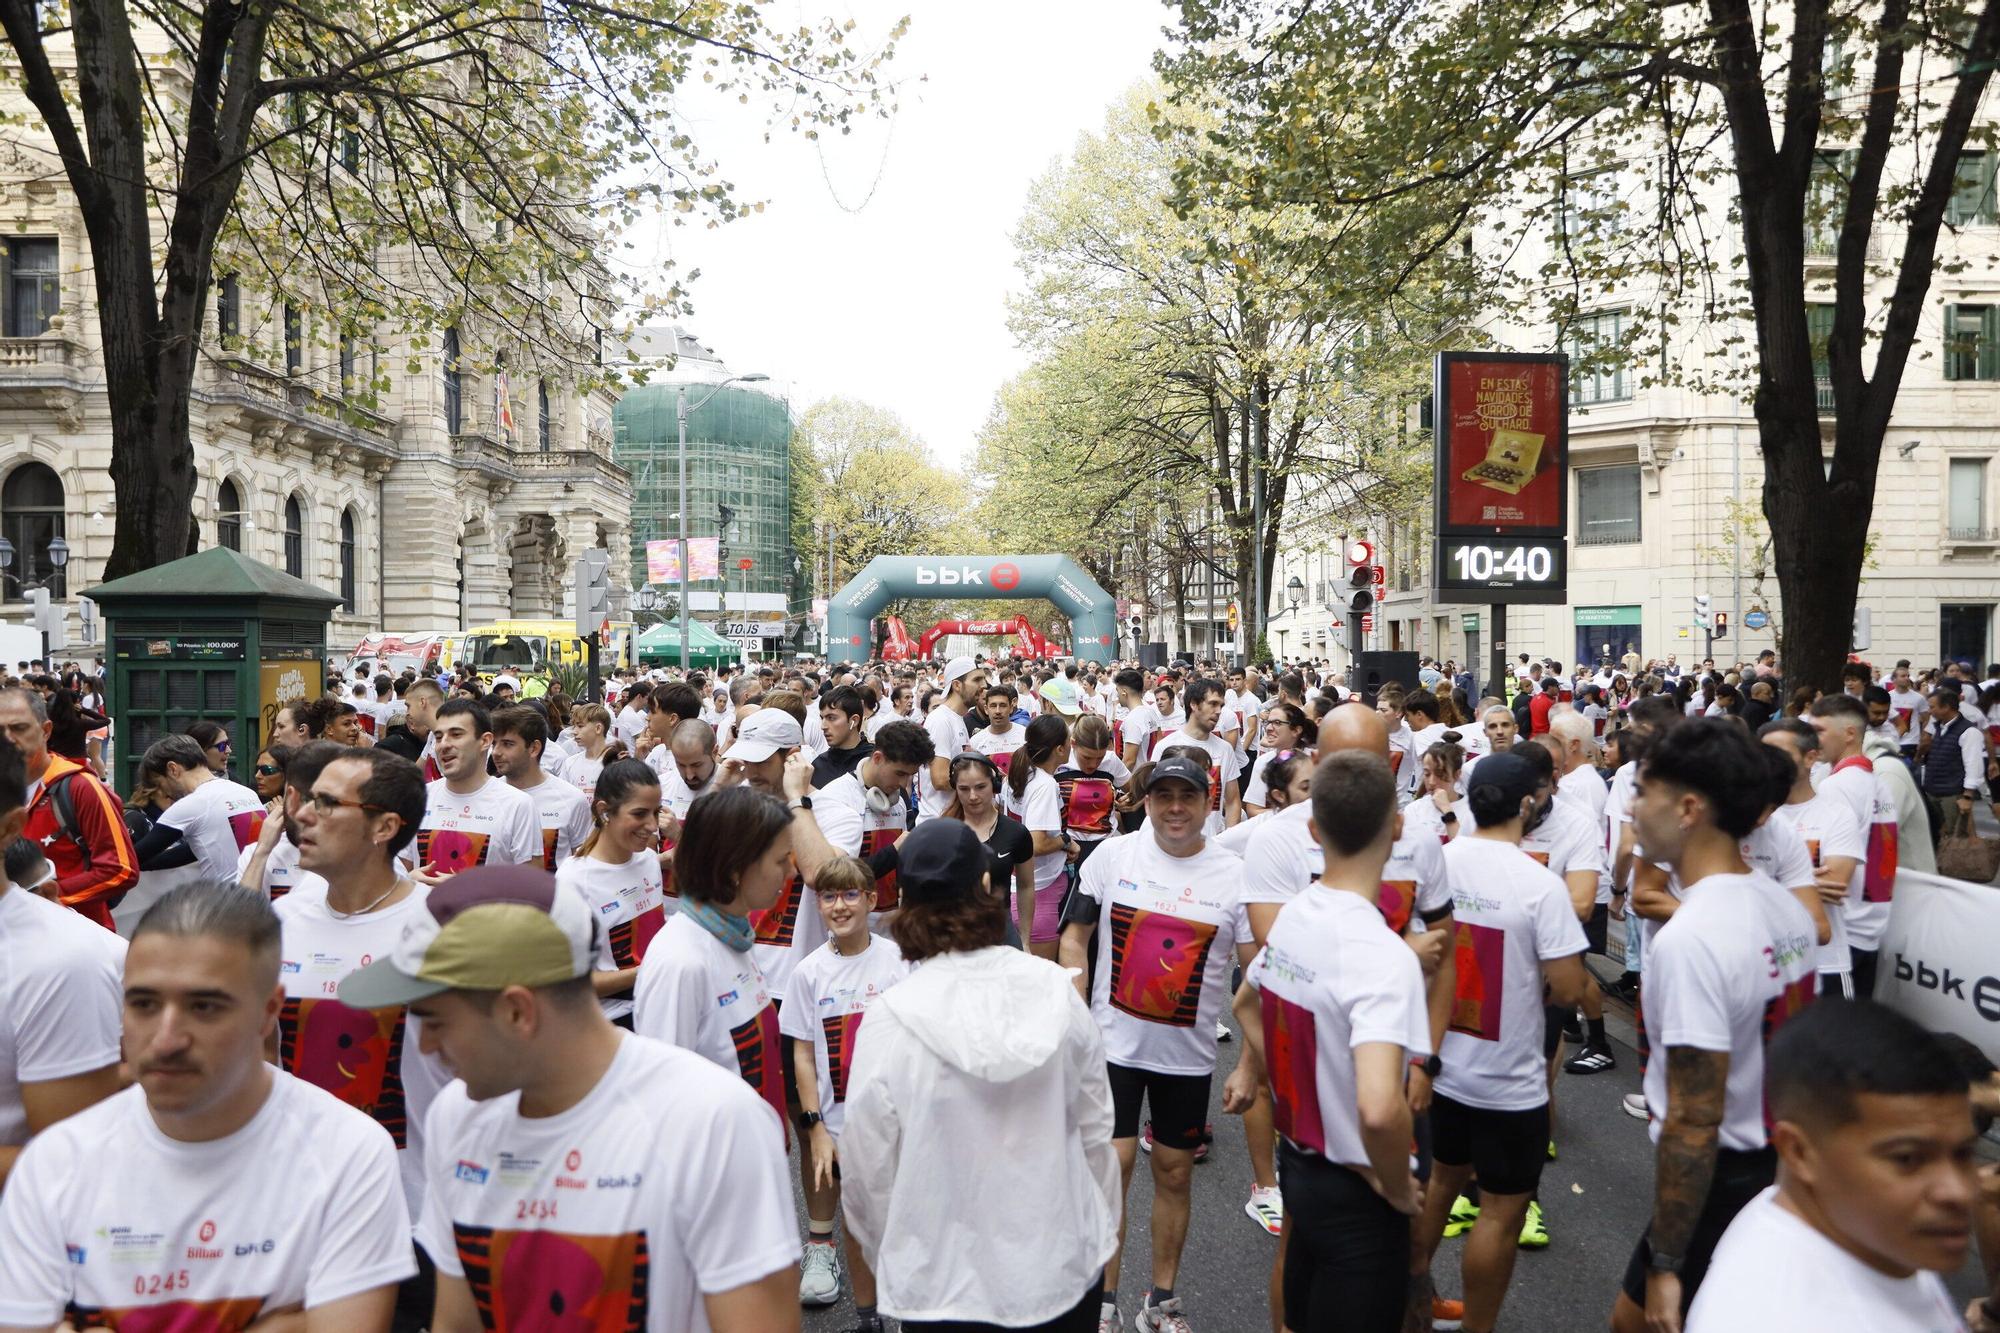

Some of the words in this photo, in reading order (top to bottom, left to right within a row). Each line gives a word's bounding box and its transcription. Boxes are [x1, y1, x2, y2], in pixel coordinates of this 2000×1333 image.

[1481, 378, 1494, 390] EN
[1497, 379, 1528, 391] ESTAS
[1520, 405, 1532, 416] DE
[1454, 545, 1551, 581] 10:40
[916, 566, 983, 585] bbk
[729, 624, 759, 634] TOUS
[830, 637, 849, 645] bbk
[1078, 637, 1099, 645] bbk
[280, 670, 301, 686] AHORA
[276, 682, 305, 702] SIEMPRE
[1155, 902, 1177, 913] 1623
[1895, 953, 1965, 1000] bbk
[135, 1269, 190, 1296] 0245
